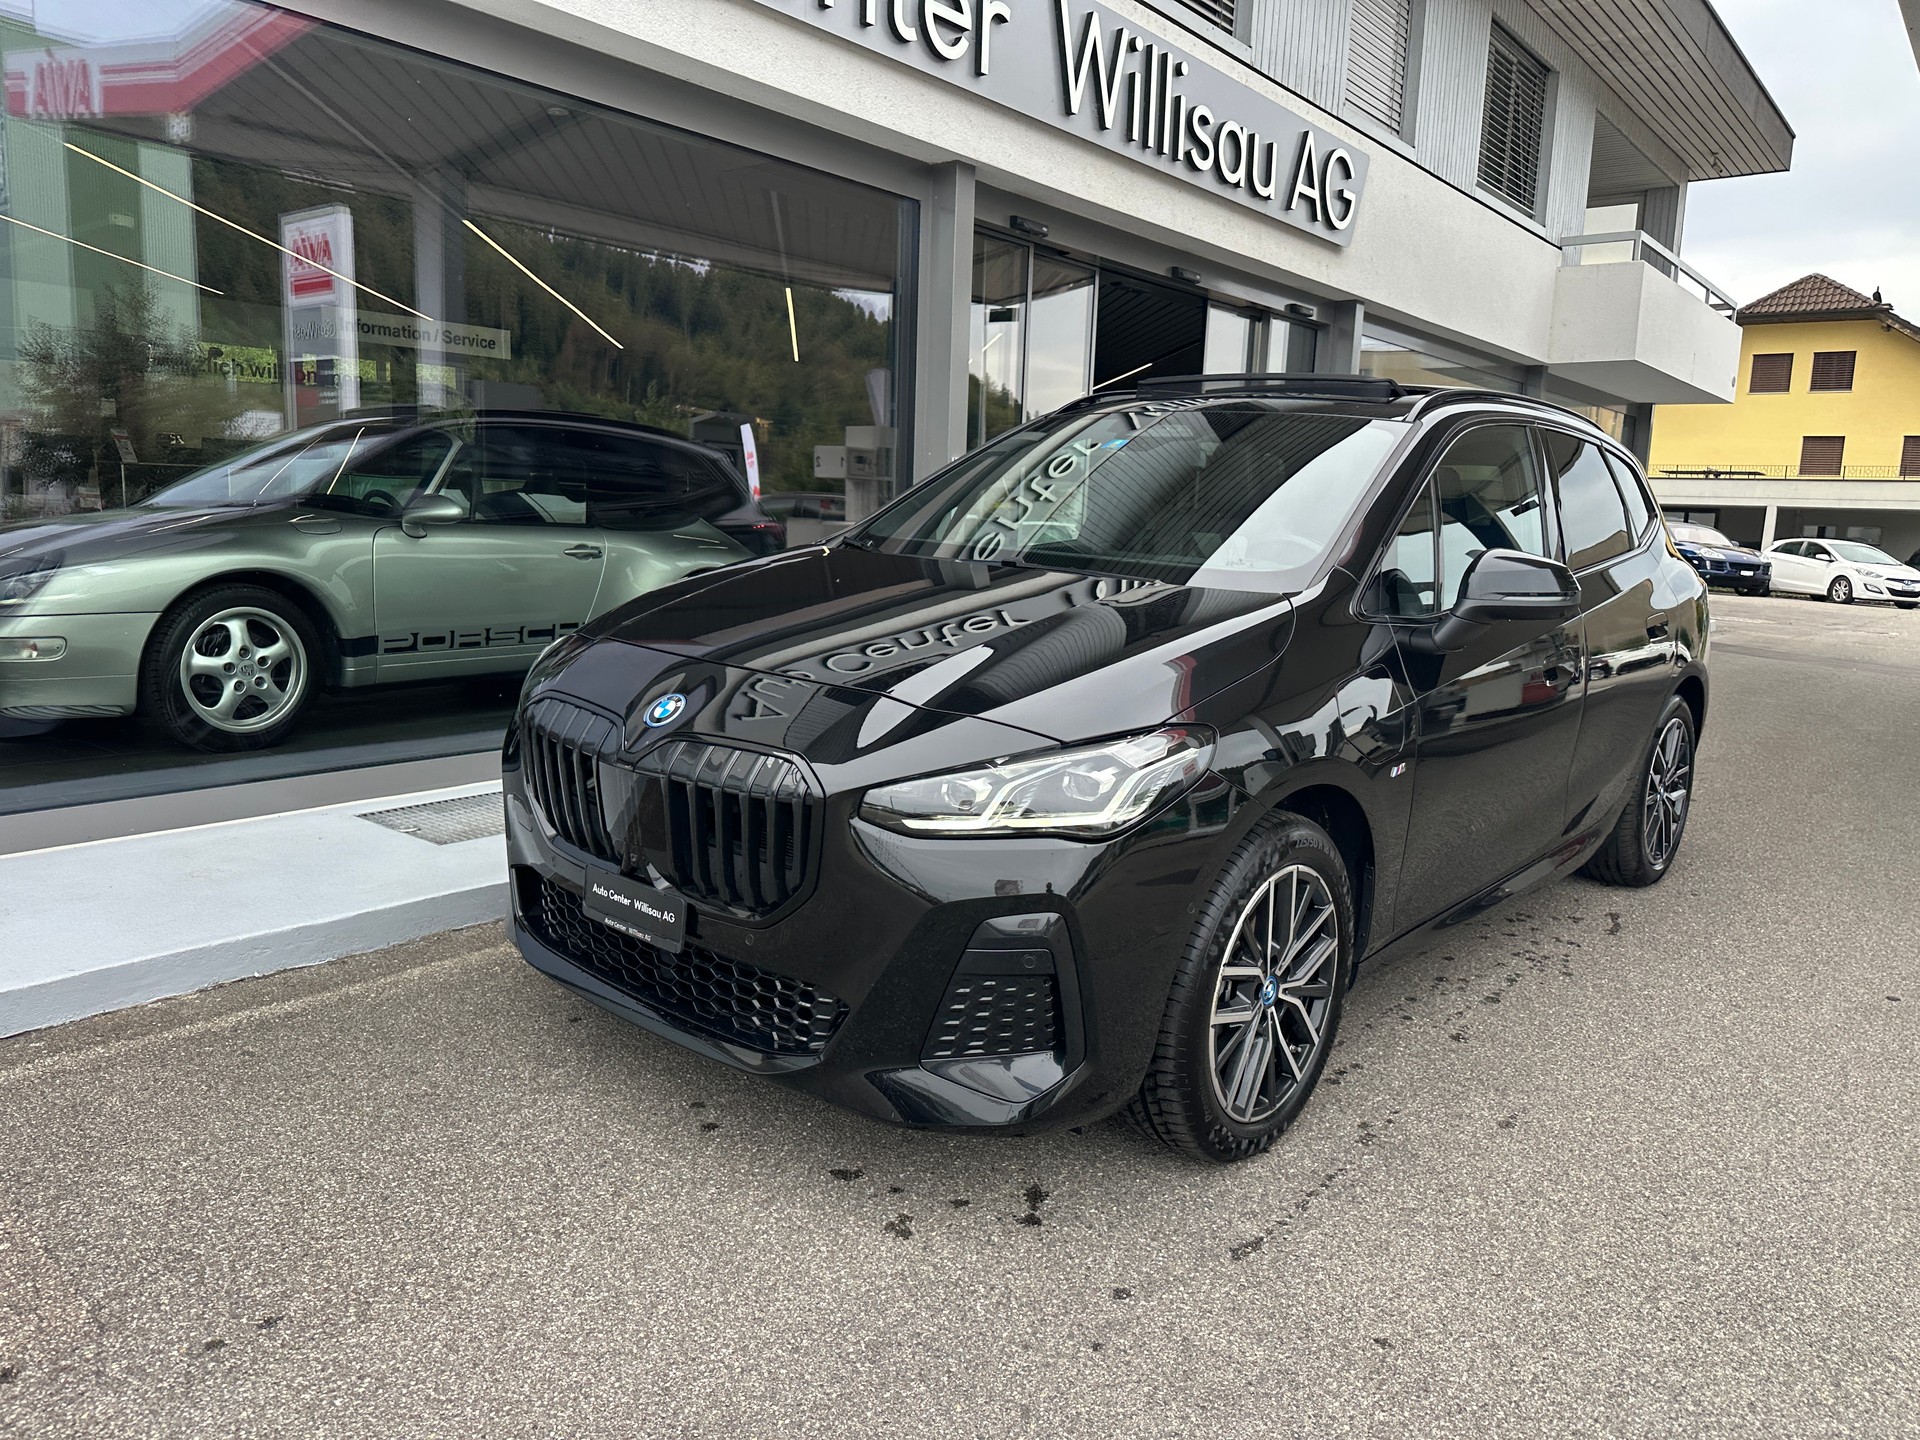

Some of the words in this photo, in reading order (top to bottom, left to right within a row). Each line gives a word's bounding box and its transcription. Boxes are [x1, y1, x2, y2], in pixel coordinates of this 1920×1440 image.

[1055, 0, 1279, 201] Willisau
[1287, 129, 1357, 231] AG
[442, 329, 497, 350] Service
[592, 883, 609, 898] Auto
[608, 890, 632, 907] Center
[633, 898, 662, 921] Willisau
[662, 910, 676, 923] AG
